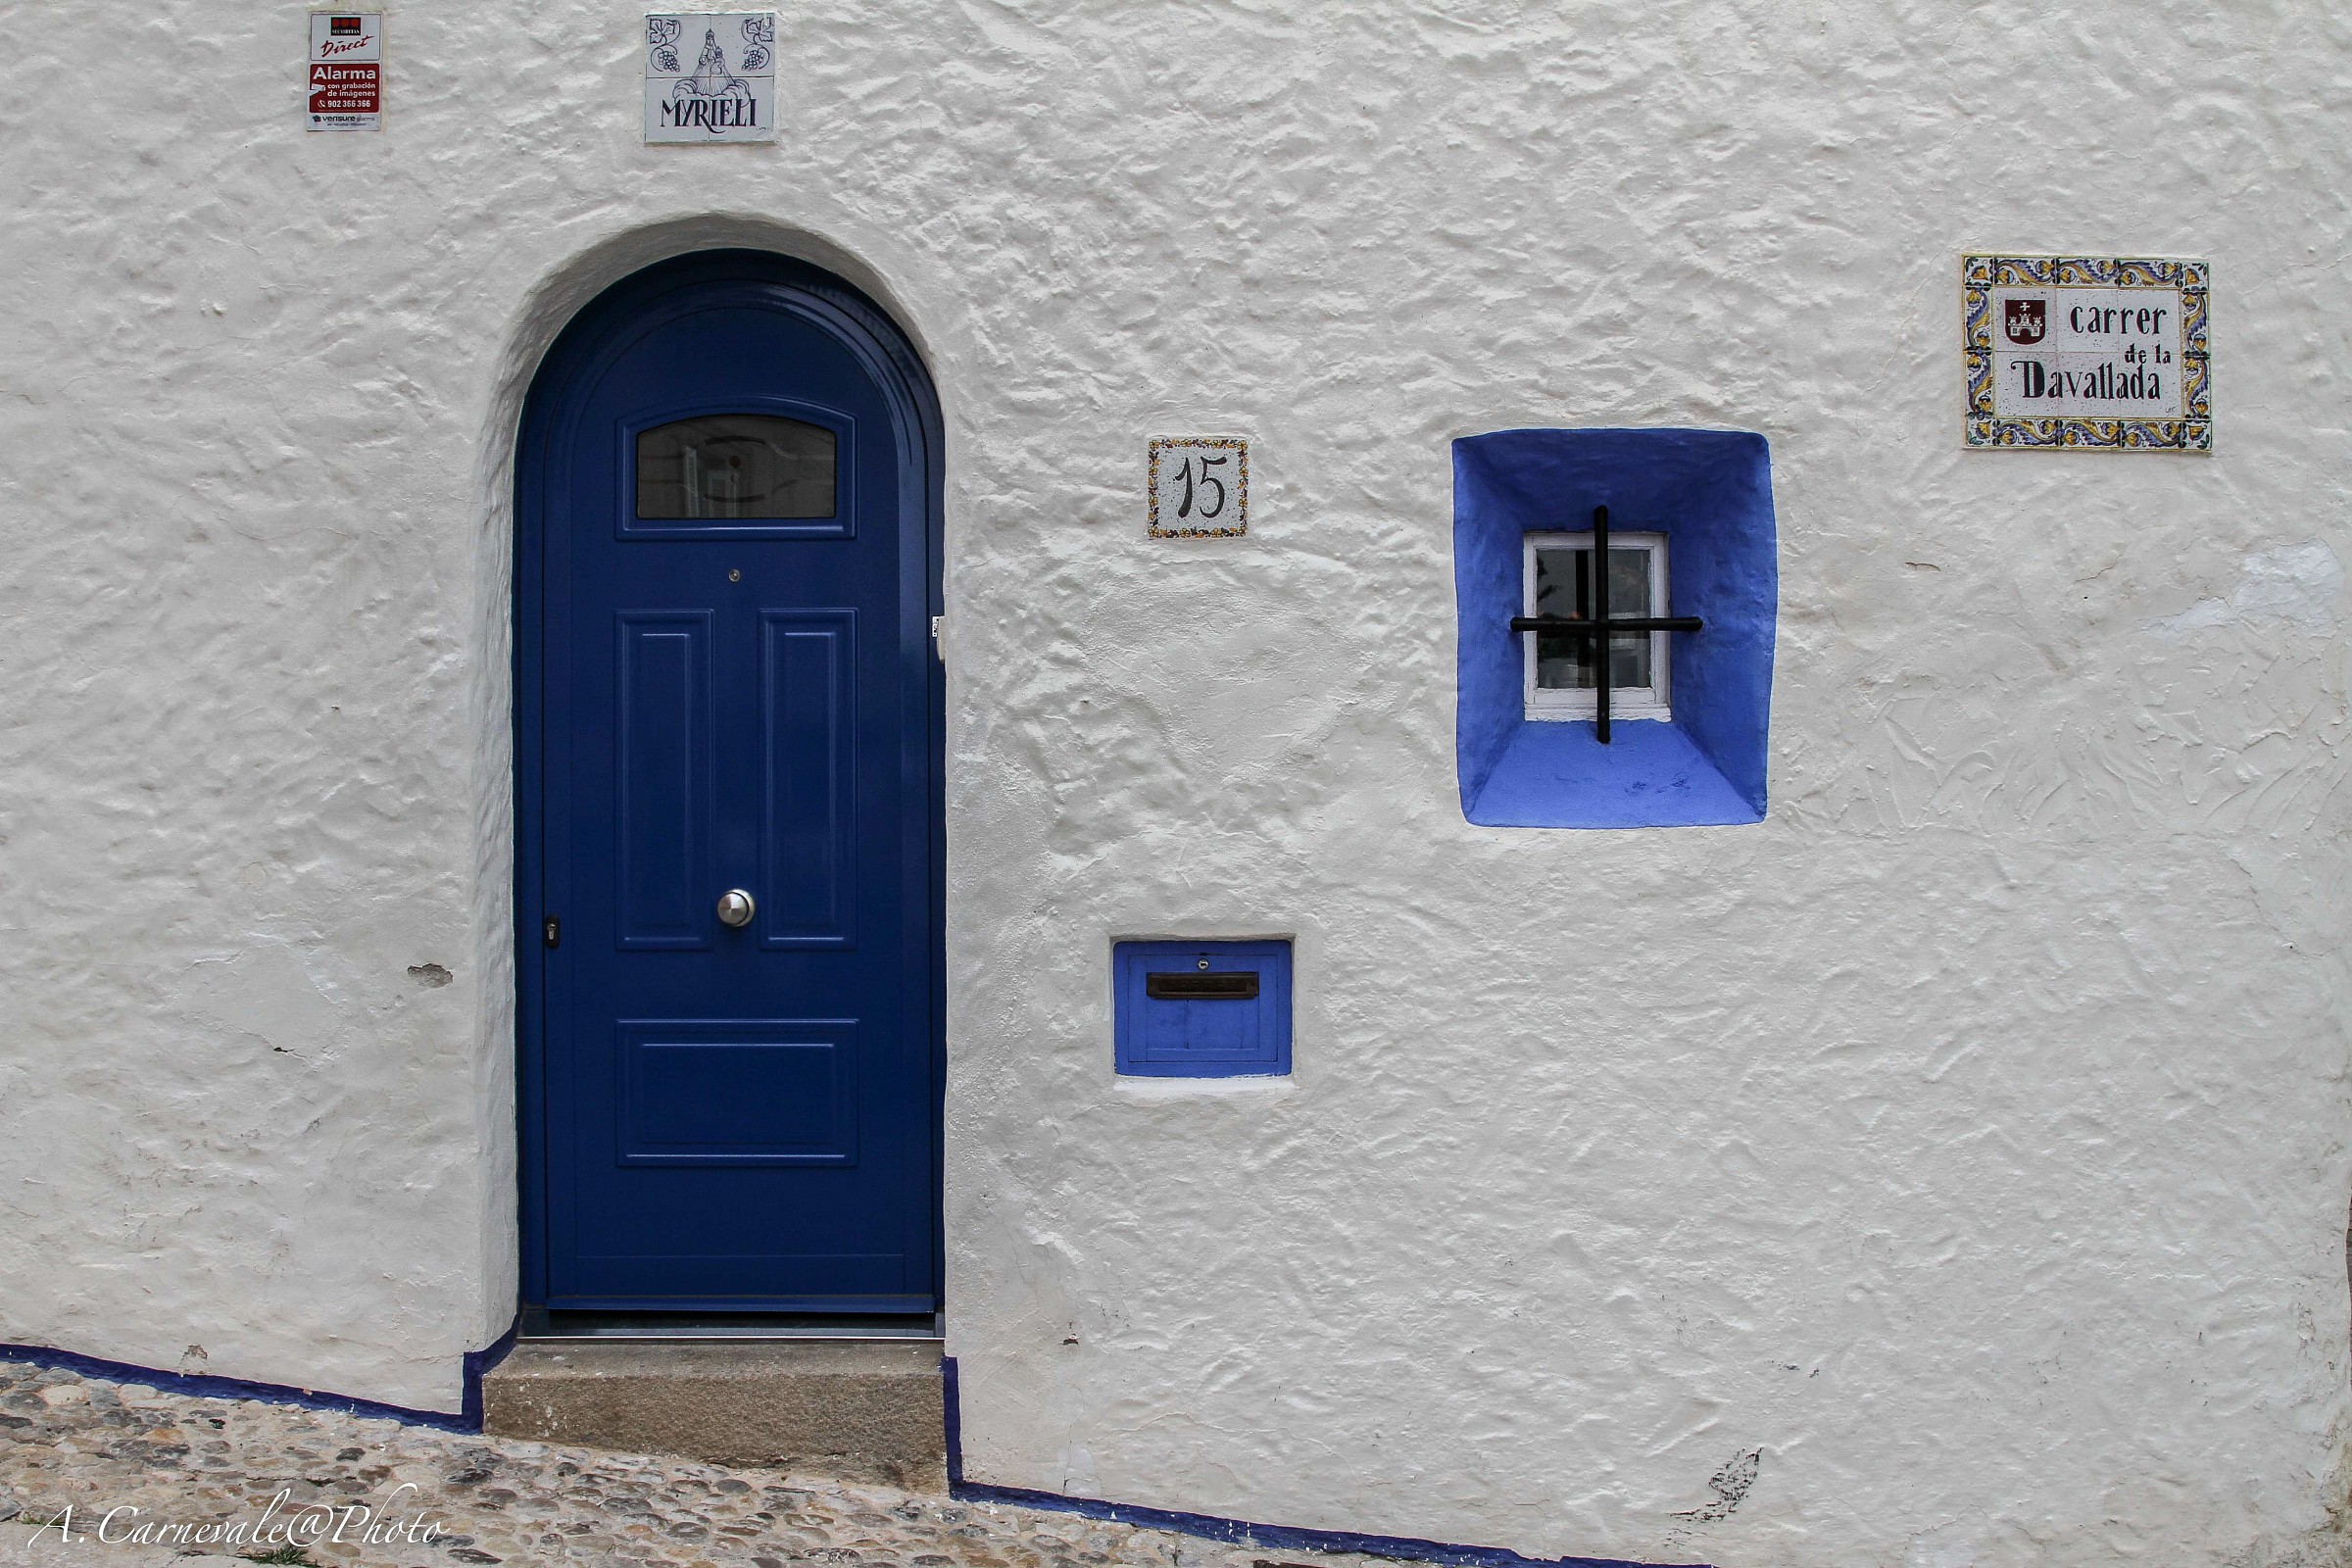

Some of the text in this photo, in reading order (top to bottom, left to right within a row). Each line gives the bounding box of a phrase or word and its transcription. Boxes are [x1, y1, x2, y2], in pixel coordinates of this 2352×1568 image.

[321, 34, 375, 58] Direct
[313, 66, 376, 79] Alarma
[327, 99, 370, 108] 902 366 366
[339, 89, 376, 99] imágenes
[660, 98, 758, 134] MYRIELI
[2124, 343, 2172, 365] de la
[2010, 360, 2161, 400] Davallada
[1175, 456, 1228, 518] 15
